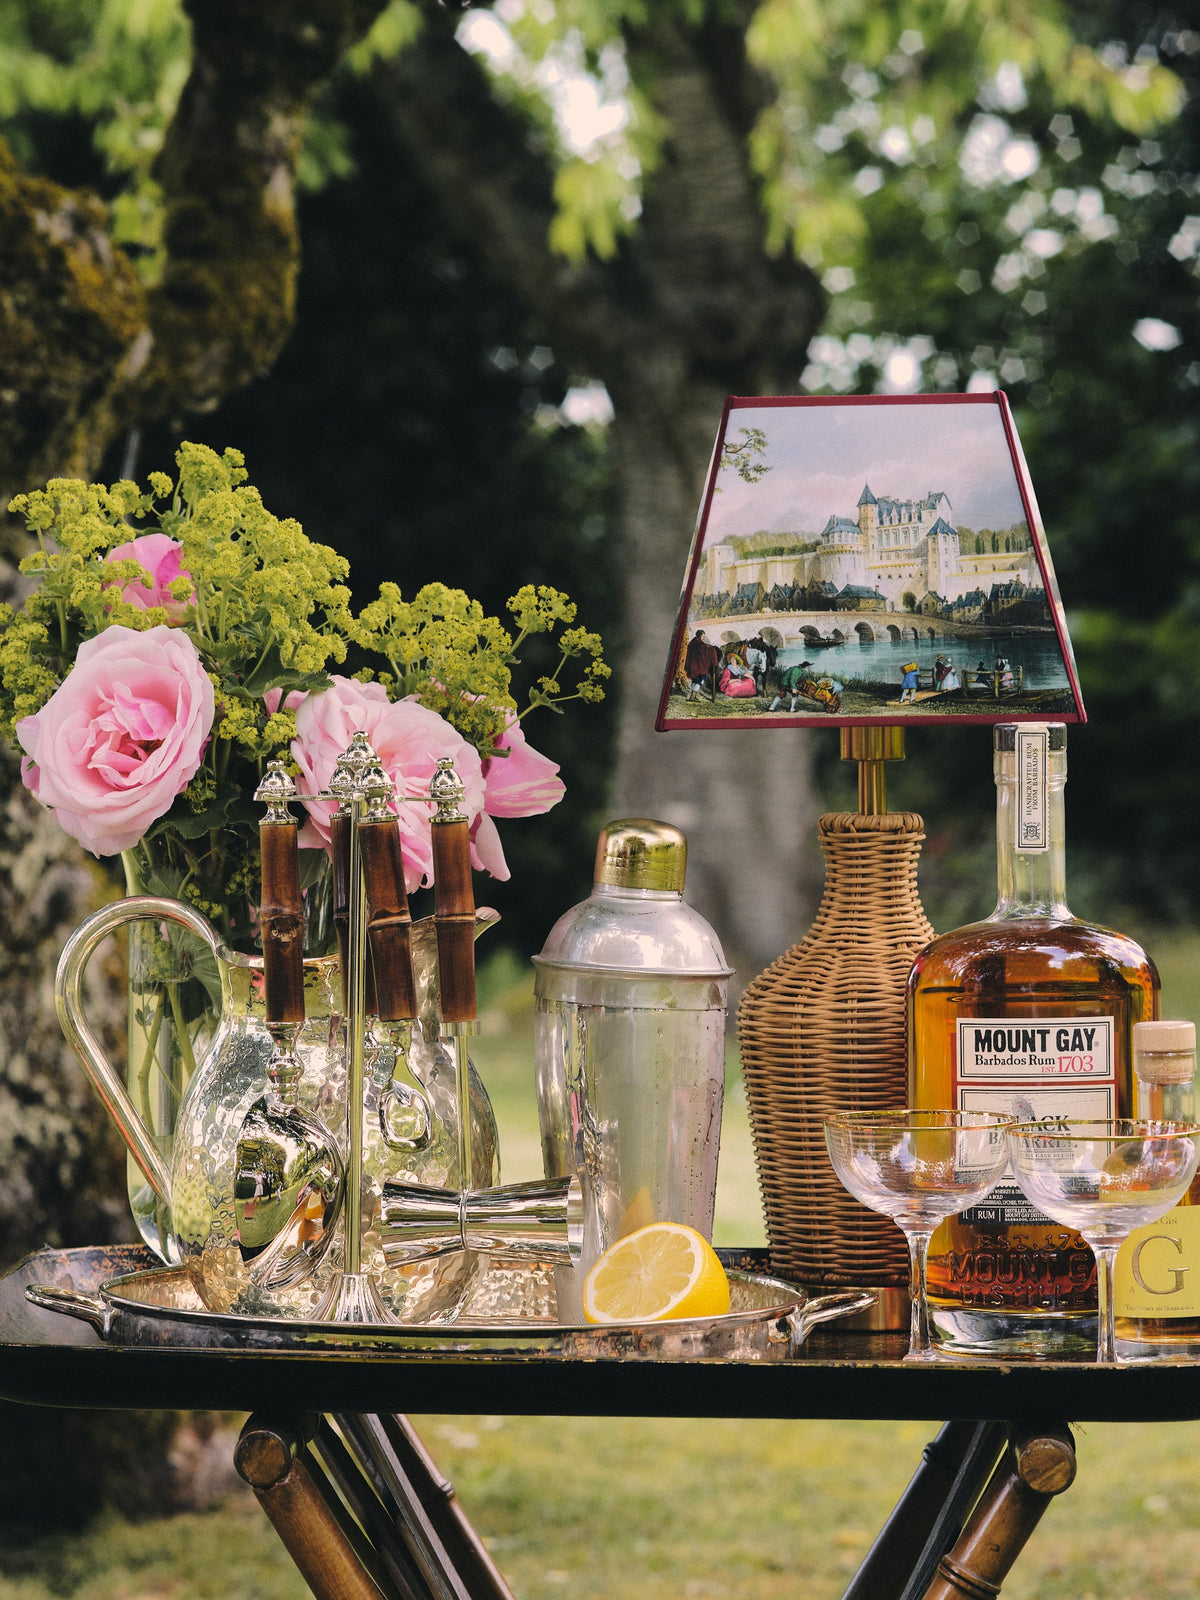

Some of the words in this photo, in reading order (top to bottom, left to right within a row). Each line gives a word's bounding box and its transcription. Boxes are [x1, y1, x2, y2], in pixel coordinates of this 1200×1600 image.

[974, 1029, 1050, 1053] MOUNT
[975, 1054, 1027, 1066] Barbados
[1029, 1054, 1056, 1065] Rum
[1057, 1055, 1094, 1073] 1703
[977, 1210, 996, 1219] RUM
[949, 1250, 1059, 1285] MOUNT
[1131, 1234, 1190, 1295] G
